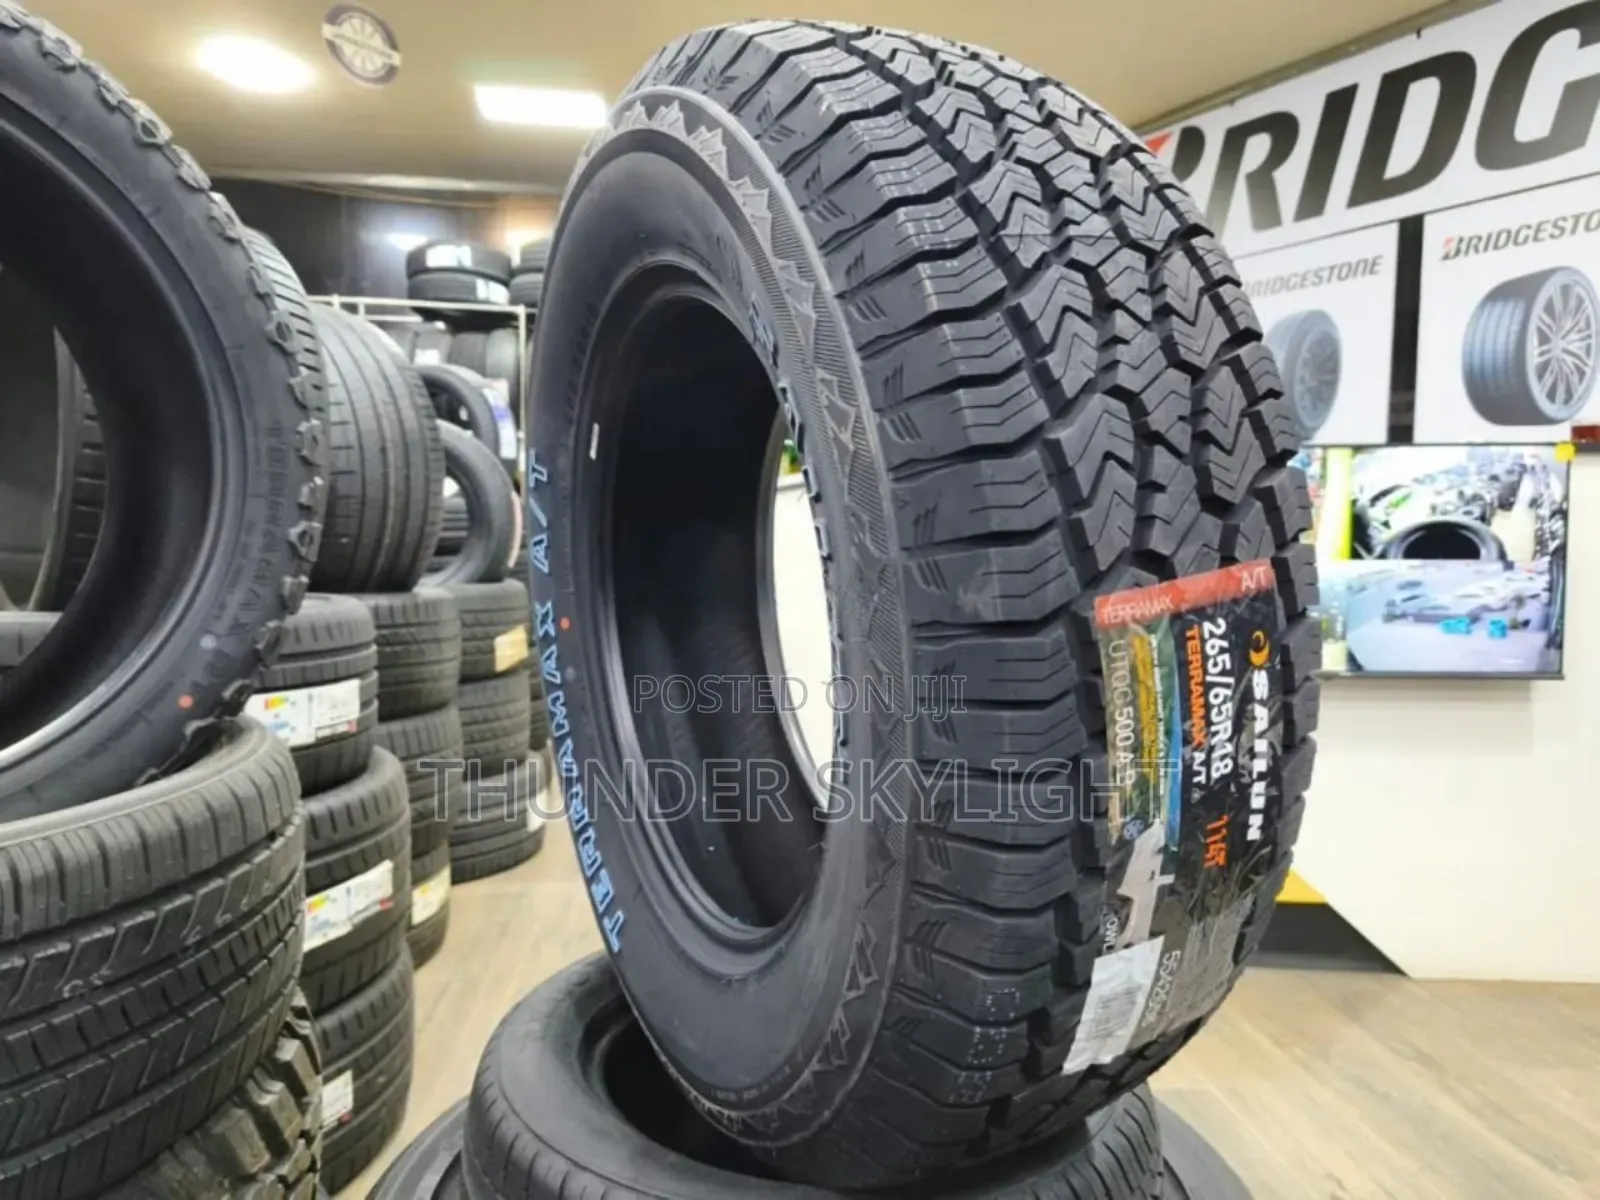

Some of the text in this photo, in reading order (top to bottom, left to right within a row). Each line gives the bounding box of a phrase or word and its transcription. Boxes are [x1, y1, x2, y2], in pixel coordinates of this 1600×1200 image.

[1100, 566, 1267, 625] TERRAMAX A/T
[527, 447, 626, 953] TERRAMAX A/T
[1113, 705, 1135, 747] 500
[1184, 624, 1208, 785] TERRAMAX A/T
[1201, 617, 1236, 781] 265/65R18
[1246, 669, 1271, 842] SAILUN
